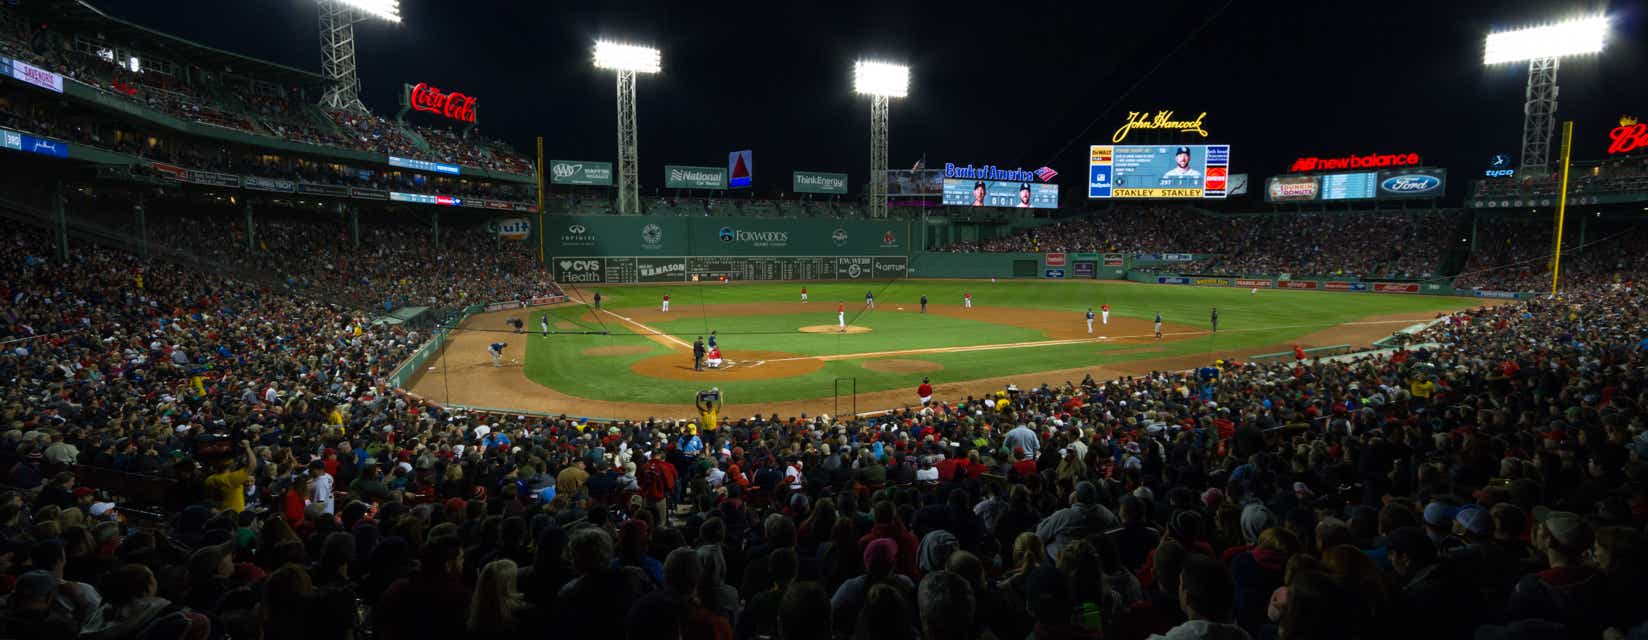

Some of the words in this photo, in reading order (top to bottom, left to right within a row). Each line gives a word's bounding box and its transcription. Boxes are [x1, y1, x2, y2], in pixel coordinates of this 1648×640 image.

[1151, 110, 1208, 137] Hancock
[1351, 153, 1419, 168] balance
[682, 171, 722, 181] National
[945, 162, 975, 177] Bank
[977, 165, 989, 179] of
[990, 166, 1034, 181] America
[1485, 169, 1515, 177] tyco
[1391, 178, 1429, 190] Ford
[573, 260, 600, 271] CVS
[562, 271, 600, 282] Health
